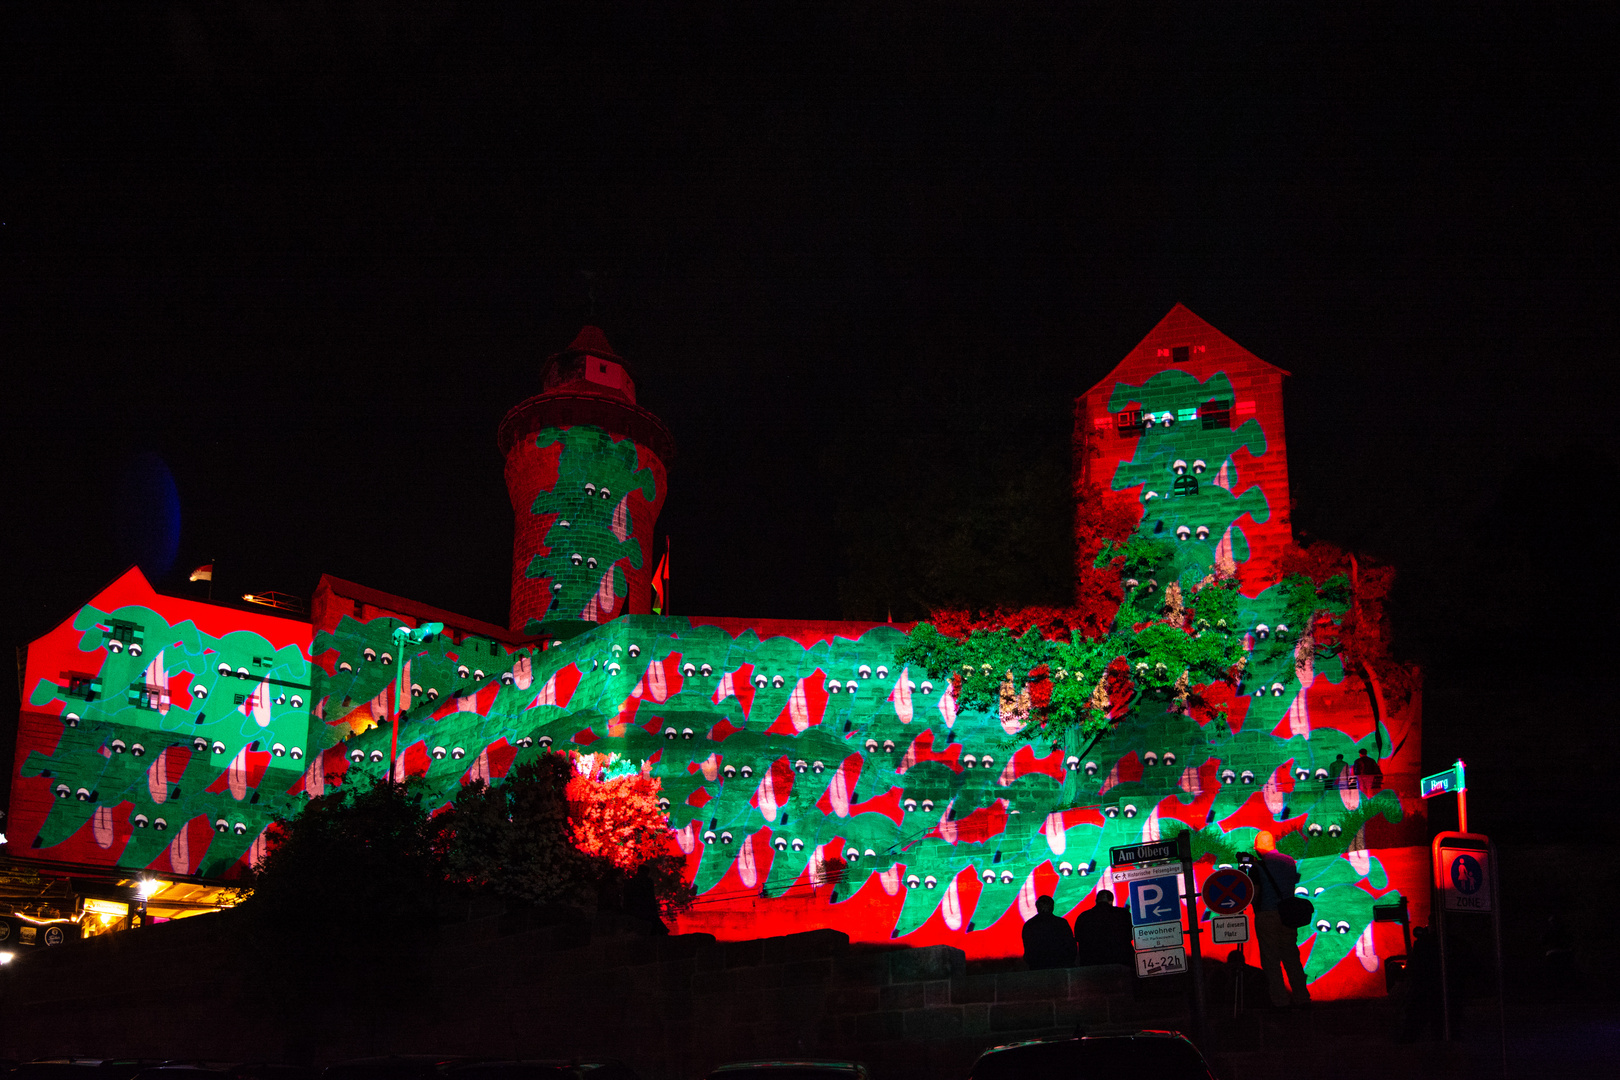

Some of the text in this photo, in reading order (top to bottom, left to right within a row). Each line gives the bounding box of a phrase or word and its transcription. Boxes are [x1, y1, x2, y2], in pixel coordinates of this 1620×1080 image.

[1430, 778, 1449, 791] Burg
[1118, 845, 1170, 862] Am Ölberg
[1137, 884, 1164, 919] P
[1456, 896, 1481, 908] ZONE
[1138, 927, 1176, 937] Bewohner
[1142, 955, 1181, 969] 14-22h
